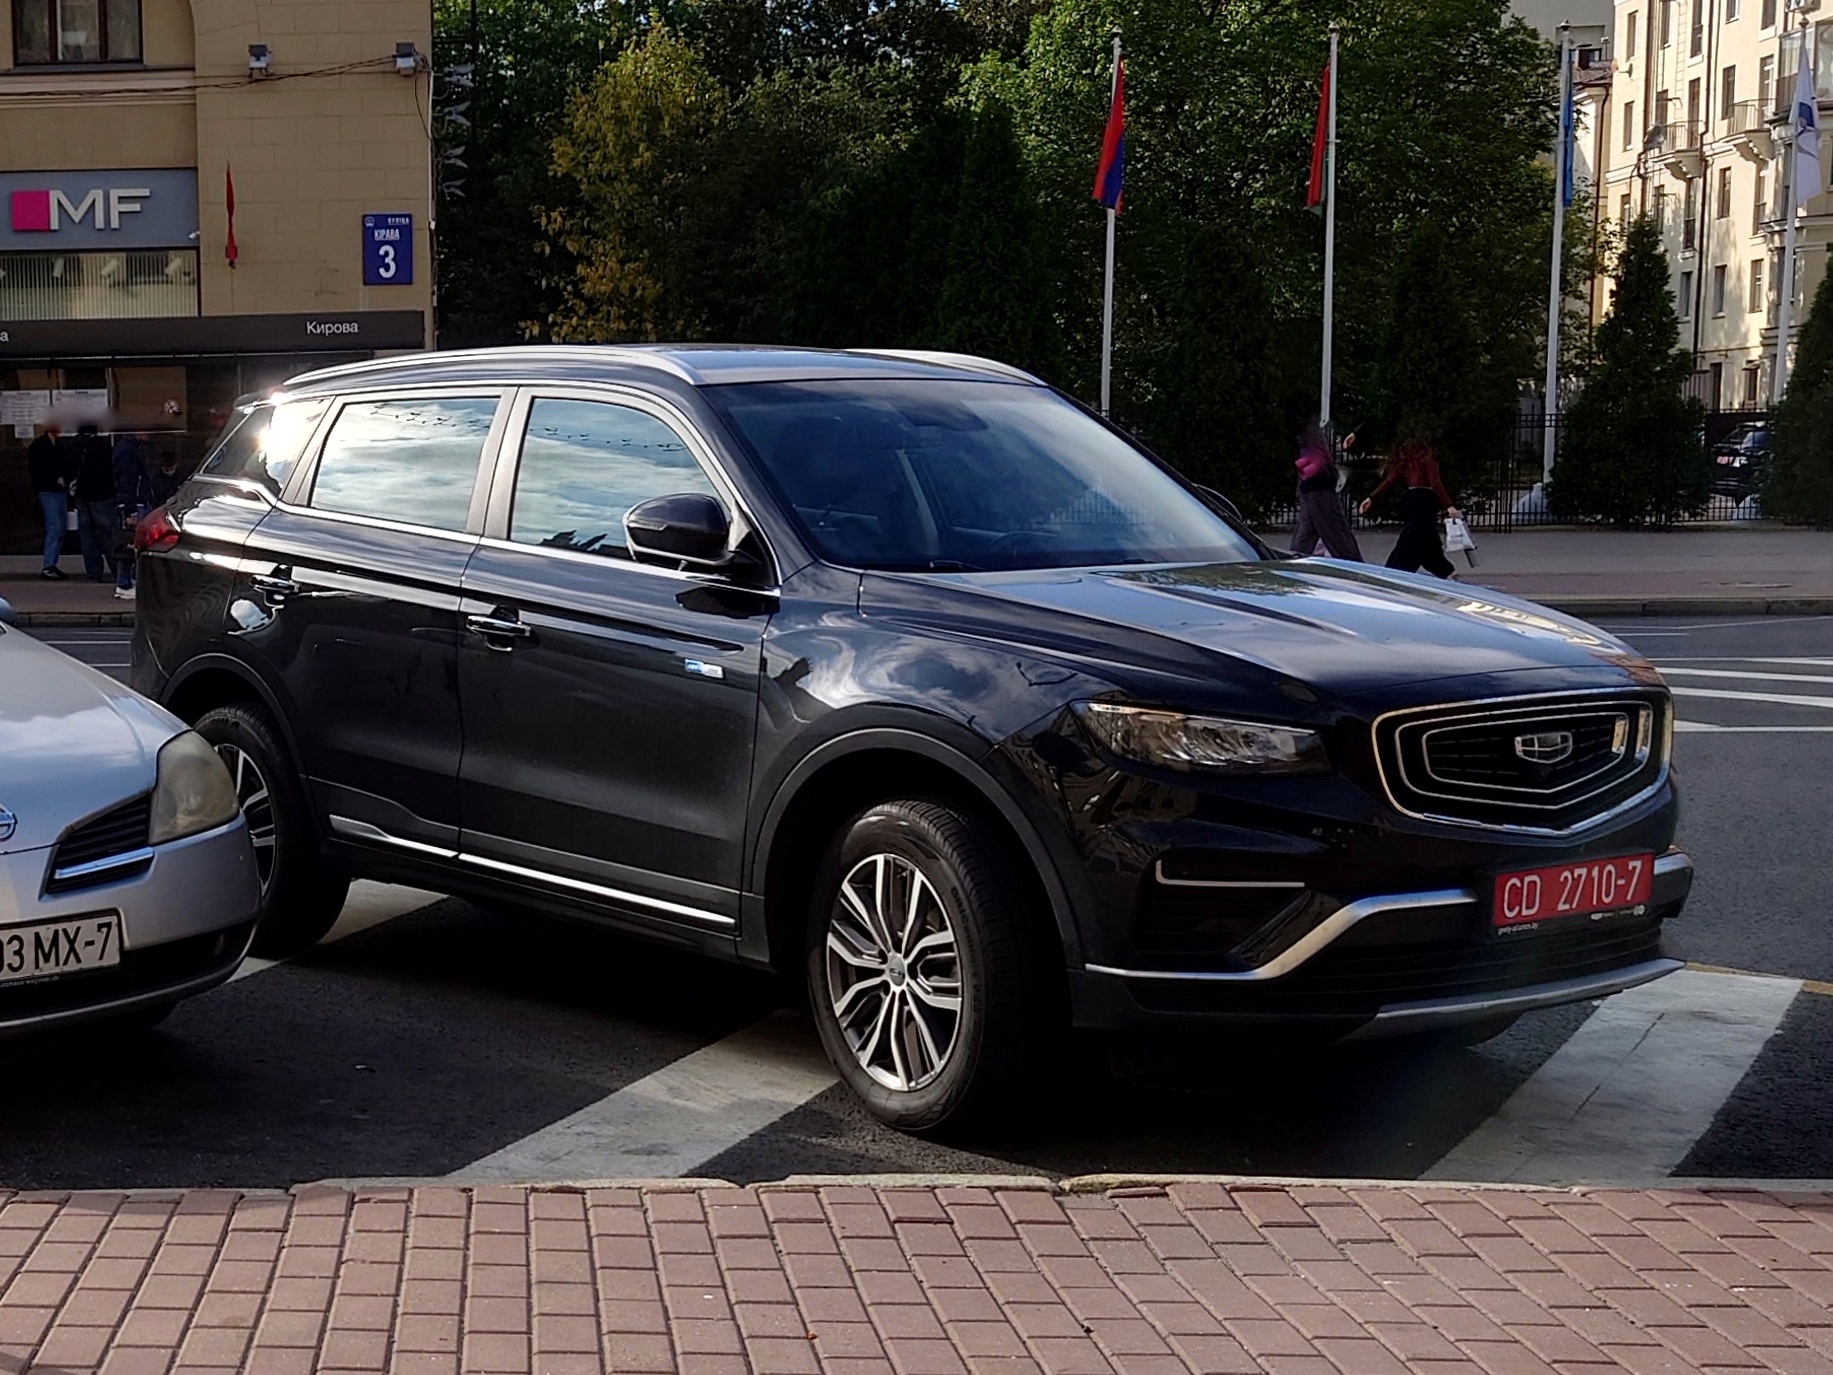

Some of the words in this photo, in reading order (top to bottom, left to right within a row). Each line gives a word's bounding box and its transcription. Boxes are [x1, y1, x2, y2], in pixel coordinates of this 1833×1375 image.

[50, 188, 150, 230] MF
[378, 244, 397, 279] 3
[306, 321, 359, 337] Кирова
[1503, 874, 1542, 918] CD
[1557, 859, 1643, 912] 2710-7
[34, 921, 113, 970] MX-7
